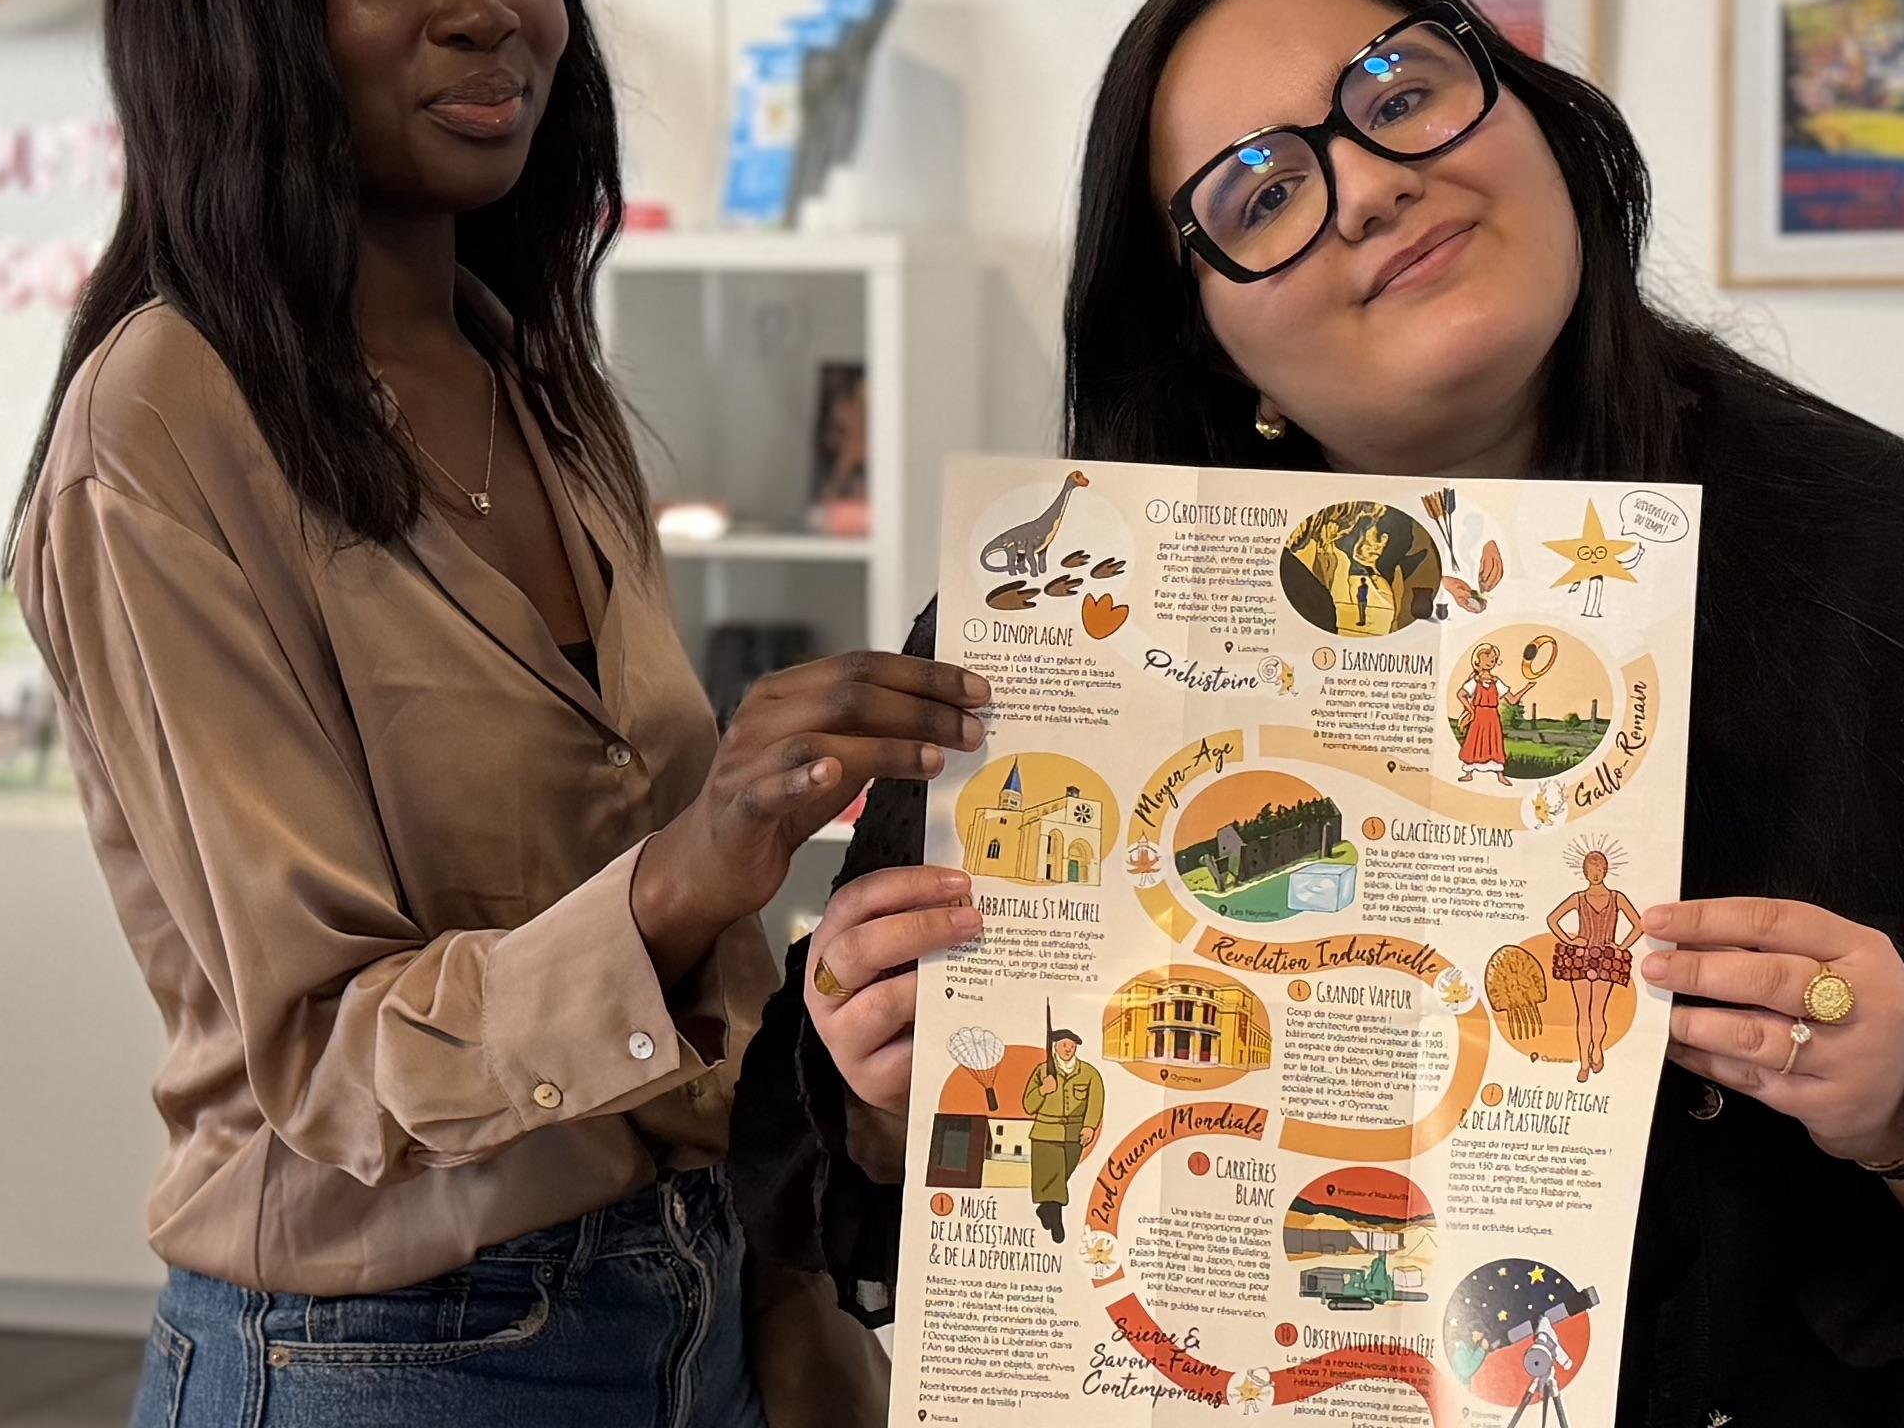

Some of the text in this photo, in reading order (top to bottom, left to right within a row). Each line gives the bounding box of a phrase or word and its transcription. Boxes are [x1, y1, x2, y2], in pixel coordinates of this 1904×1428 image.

[1173, 500, 1221, 526] GROTTES
[1223, 506, 1239, 526] DE
[1240, 505, 1288, 529] CERDON
[992, 621, 1074, 648] DINOPLAGNE
[1341, 648, 1434, 676] ISARNODURUM
[1453, 825, 1467, 846] DE
[1468, 823, 1514, 849] SYLANS
[977, 894, 1038, 921] ABBATIALE
[1315, 935, 1438, 974] Industrielle
[1315, 980, 1412, 1010] GRANDE VAPEUR
[1544, 1090, 1563, 1113] DU
[1564, 1091, 1611, 1116] PEIGNE
[1501, 1110, 1571, 1136] PLASTURGIE
[1235, 1183, 1275, 1209] BLANC
[930, 1220, 945, 1244] DE
[947, 1221, 962, 1245] LA
[942, 1248, 958, 1270] DE
[961, 1249, 976, 1270] LA
[1302, 1325, 1386, 1355] OBSERVATOIRE
